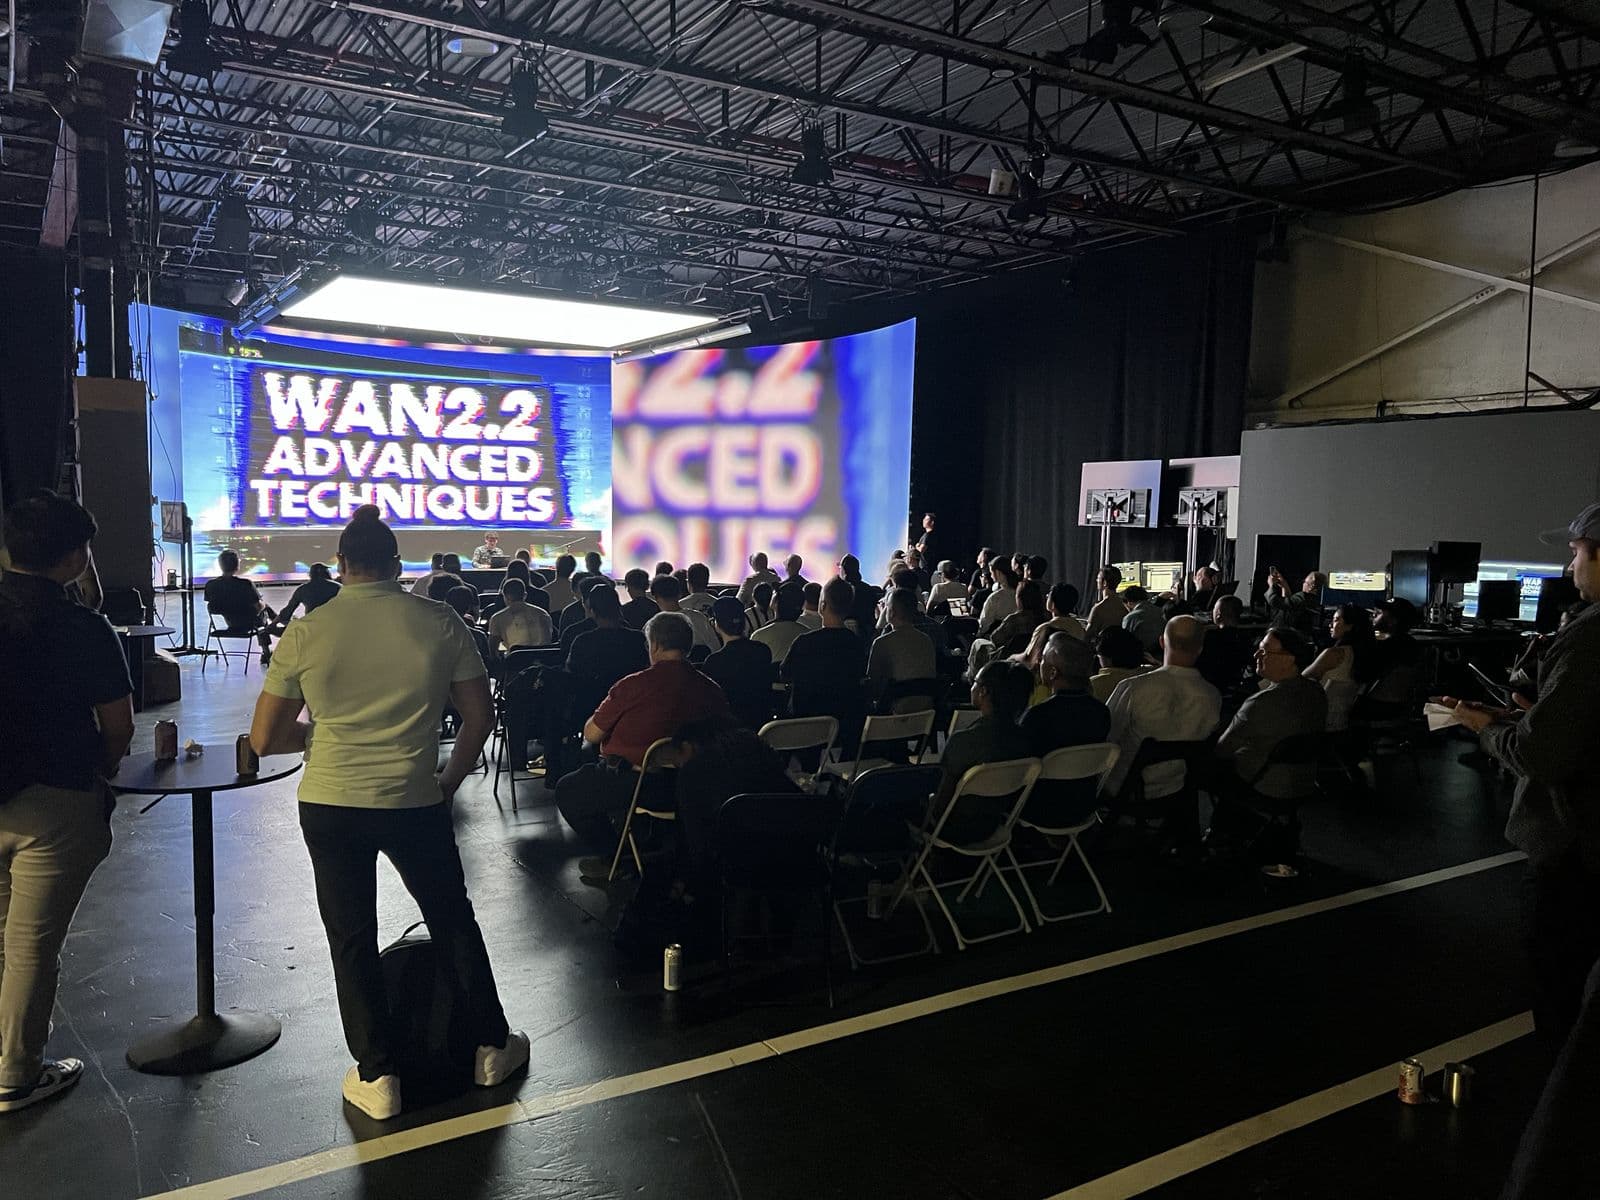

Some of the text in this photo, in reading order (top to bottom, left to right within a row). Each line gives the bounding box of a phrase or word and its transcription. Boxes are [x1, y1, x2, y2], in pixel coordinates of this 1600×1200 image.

[262, 371, 542, 441] WAN2.2
[262, 436, 543, 482] ADVANCED
[250, 480, 555, 522] TECHNIQUES
